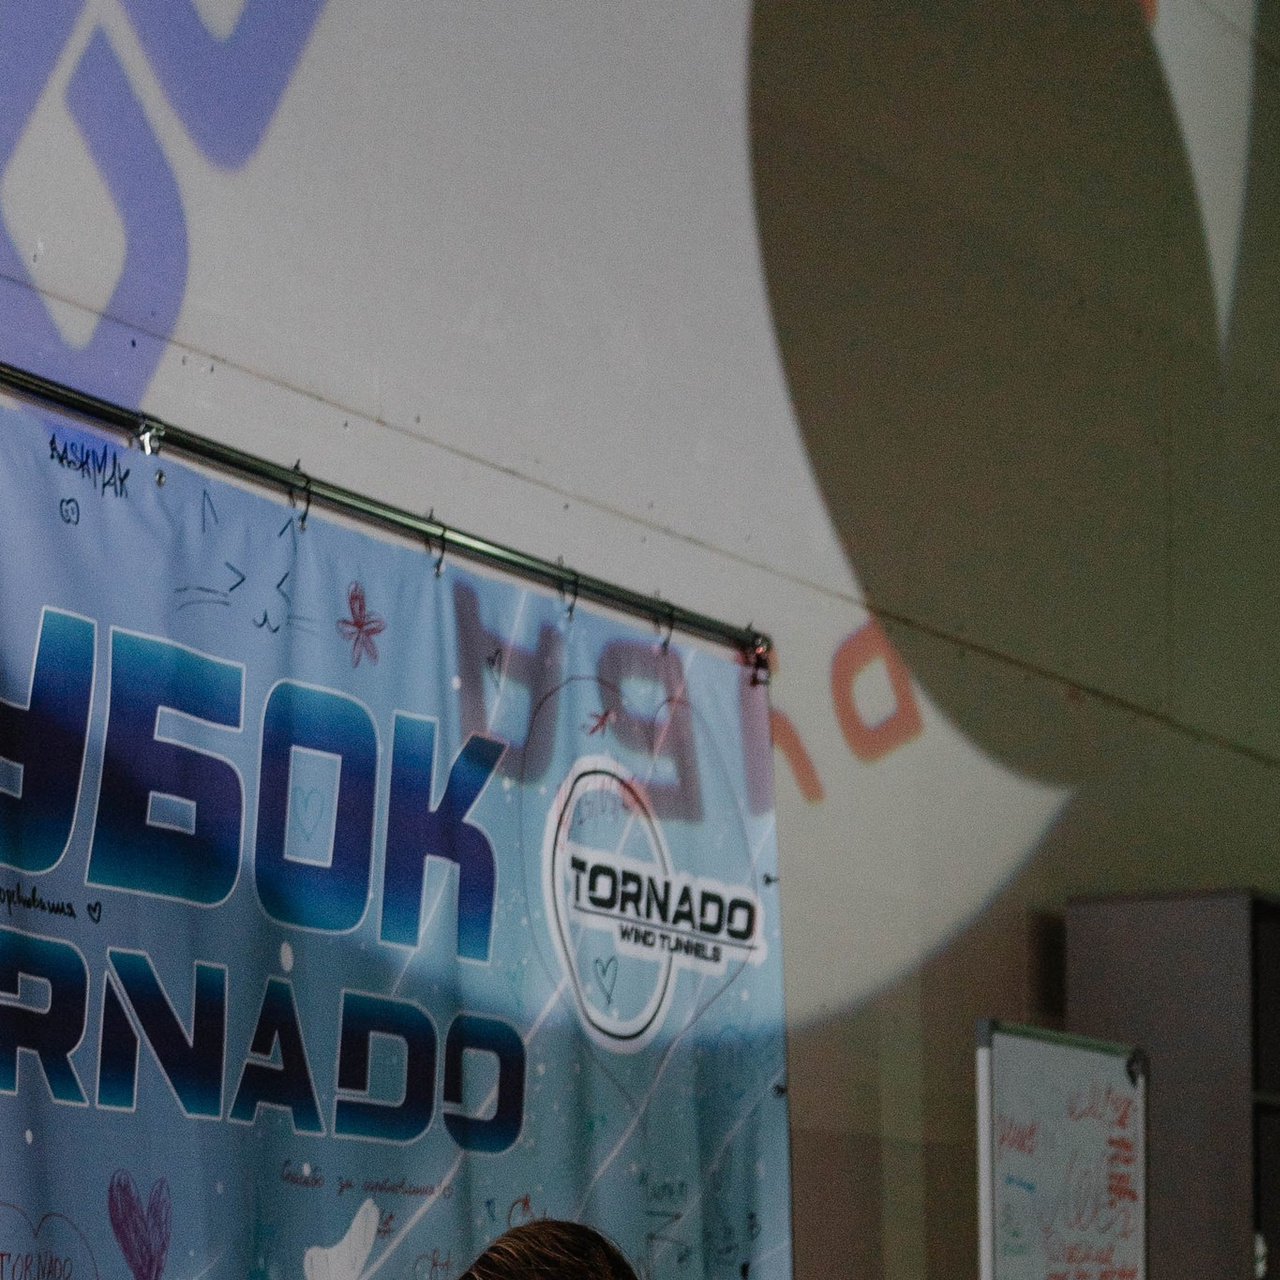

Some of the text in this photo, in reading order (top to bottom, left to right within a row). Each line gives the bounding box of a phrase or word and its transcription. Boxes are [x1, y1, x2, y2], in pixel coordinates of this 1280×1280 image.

[571, 855, 757, 941] TORNADO
[620, 925, 722, 963] WIND TUNNELS
